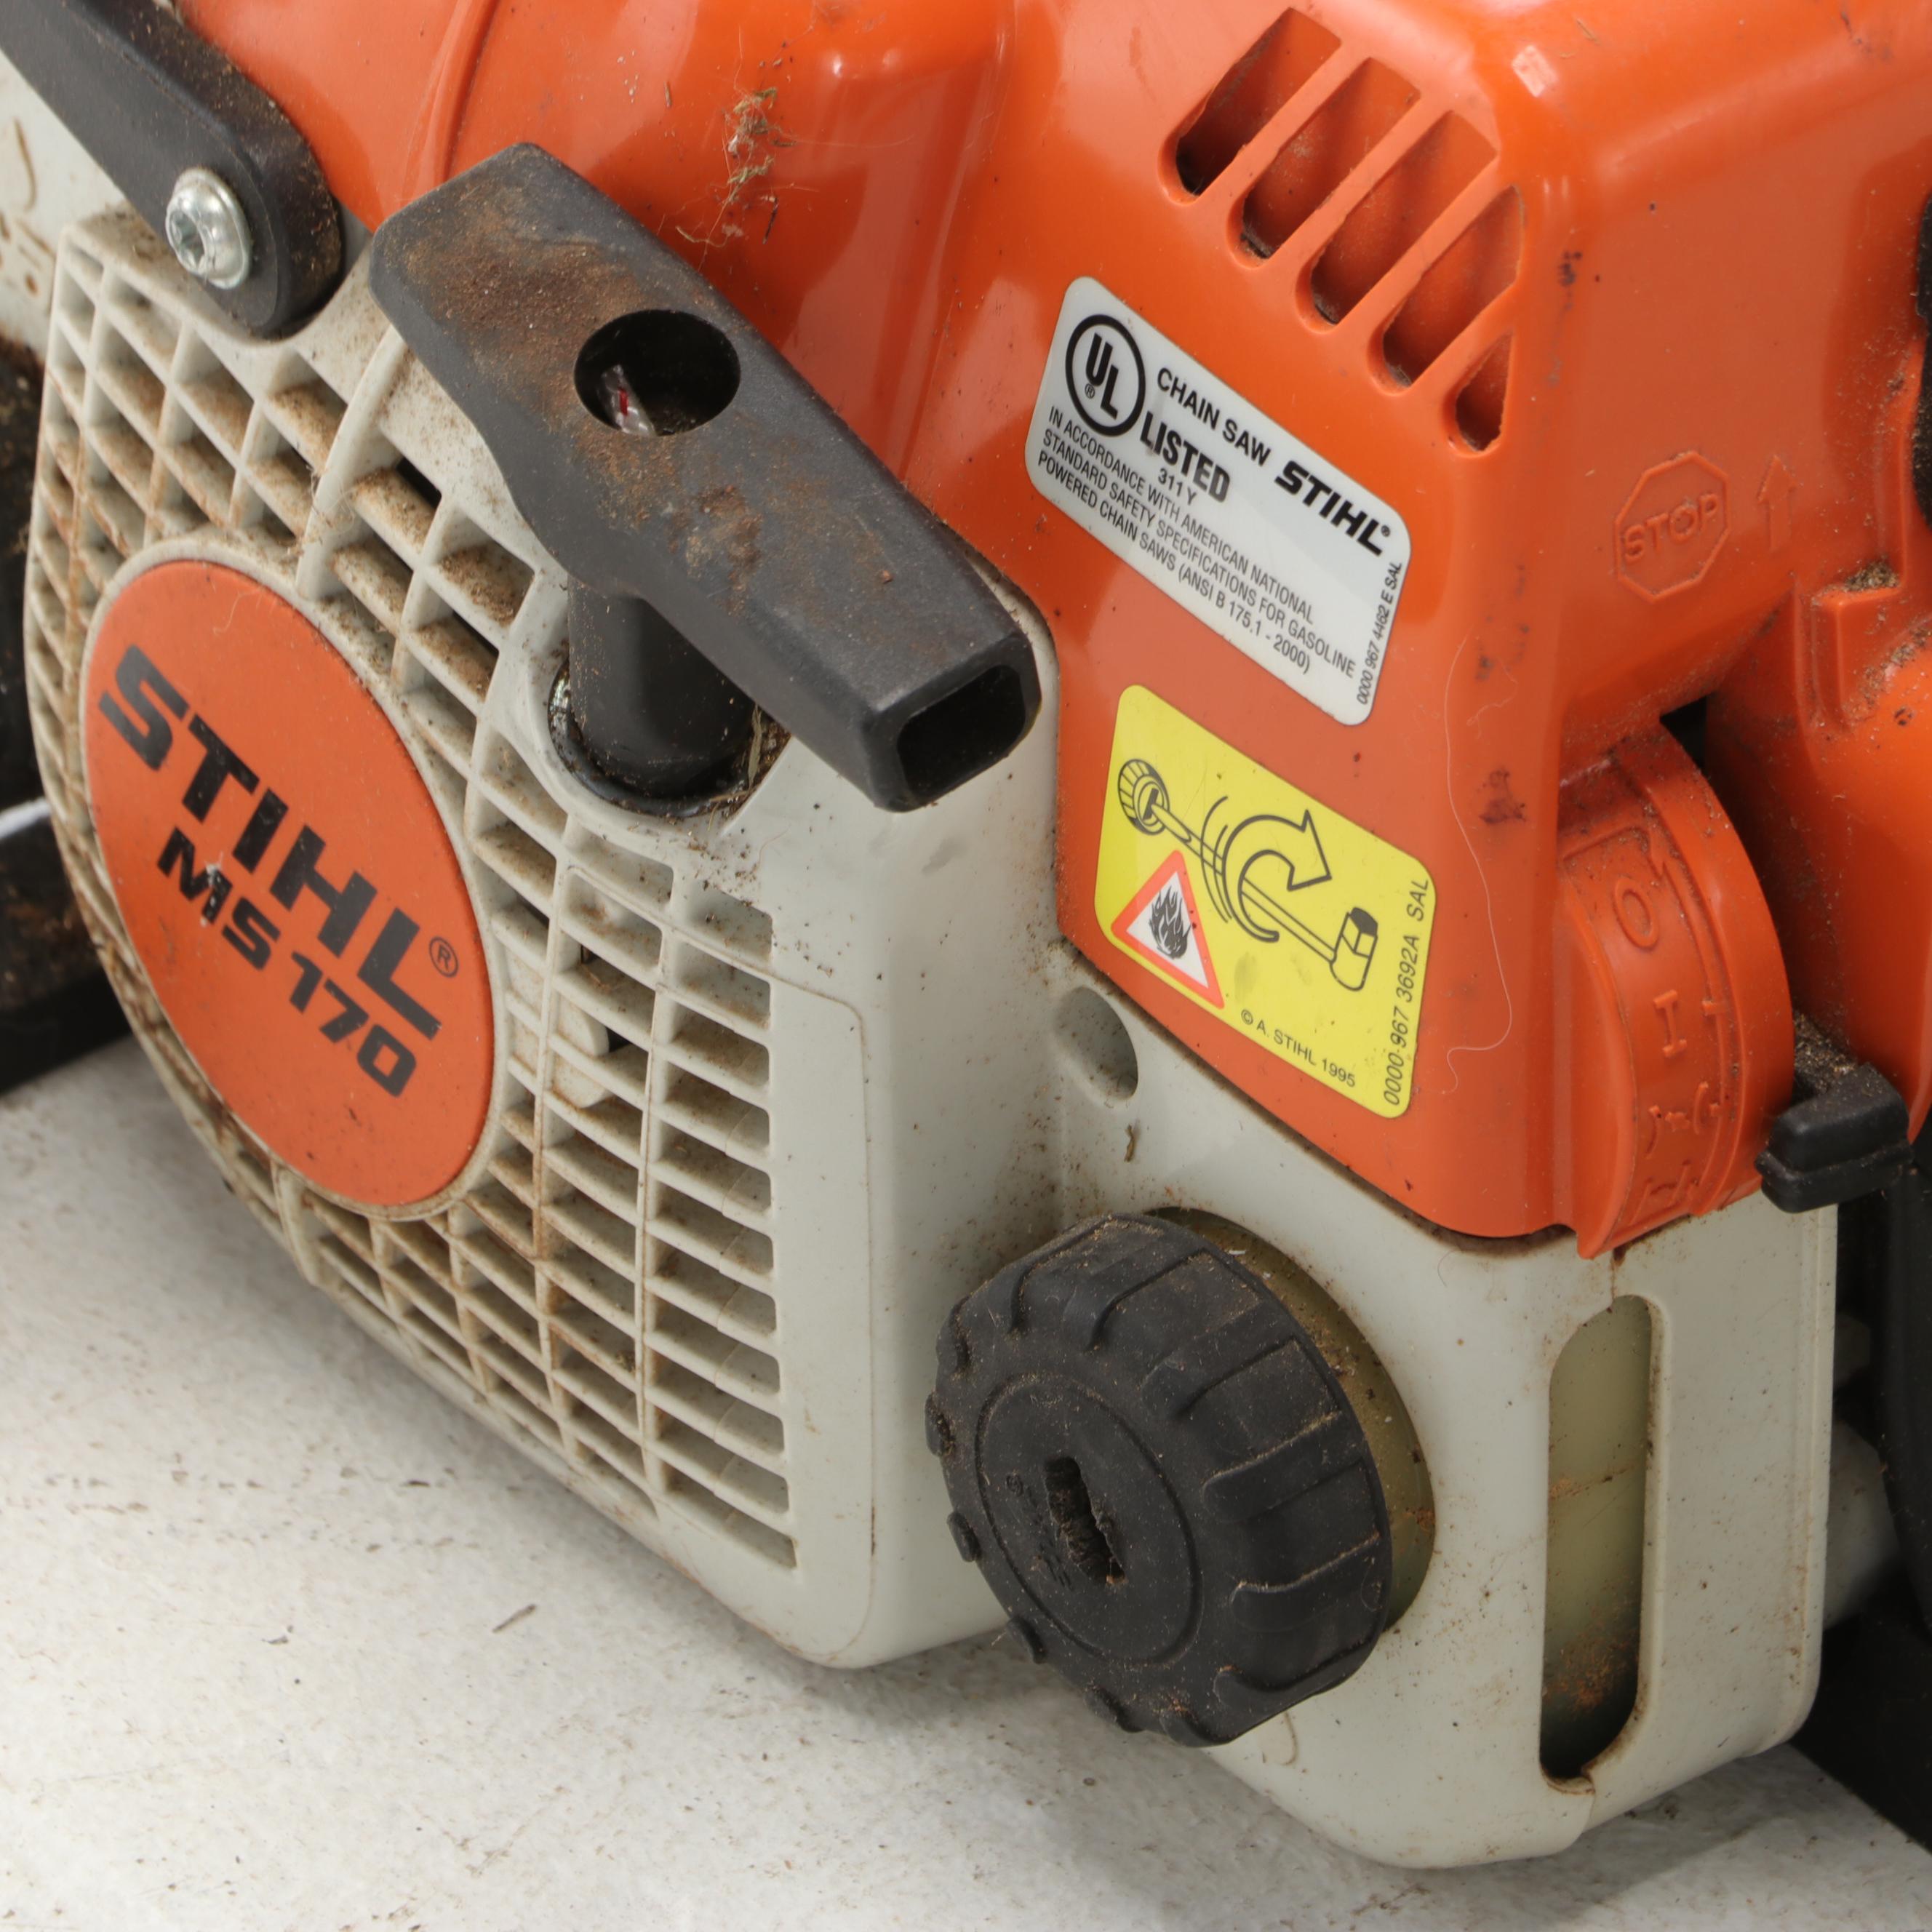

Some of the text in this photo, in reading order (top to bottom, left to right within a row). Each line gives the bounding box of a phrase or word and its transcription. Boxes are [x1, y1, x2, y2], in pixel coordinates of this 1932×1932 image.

[1140, 410, 1231, 503] LISTED
[1157, 367, 1271, 467] CHAIN SAW
[1158, 468, 1197, 506] 311 Y
[1039, 450, 1098, 508] POWERED
[1100, 500, 1138, 540] CHAIN
[1140, 532, 1175, 571] SAWS
[1178, 563, 1214, 601] (ANSI
[1216, 591, 1226, 609] B
[1229, 601, 1261, 636] 175.1
[1273, 634, 1310, 675] 2000)
[1043, 428, 1356, 678] STANDARD SAFETY SPECIFICATIONS FOR GASOLINE
[1049, 406, 1314, 625] IN ACCORDANCE WITH AMERICAN NATIONAL
[1622, 492, 1720, 562] STOP
[1357, 562, 1402, 705] 0000 967 4462 E SAL
[156, 826, 417, 1098] MS 170
[1384, 879, 1429, 1106] 0000 967 3692A SAL
[1256, 1019, 1270, 1039] A.
[1274, 1030, 1317, 1066] STIHL
[1320, 1057, 1357, 1087] 1995
